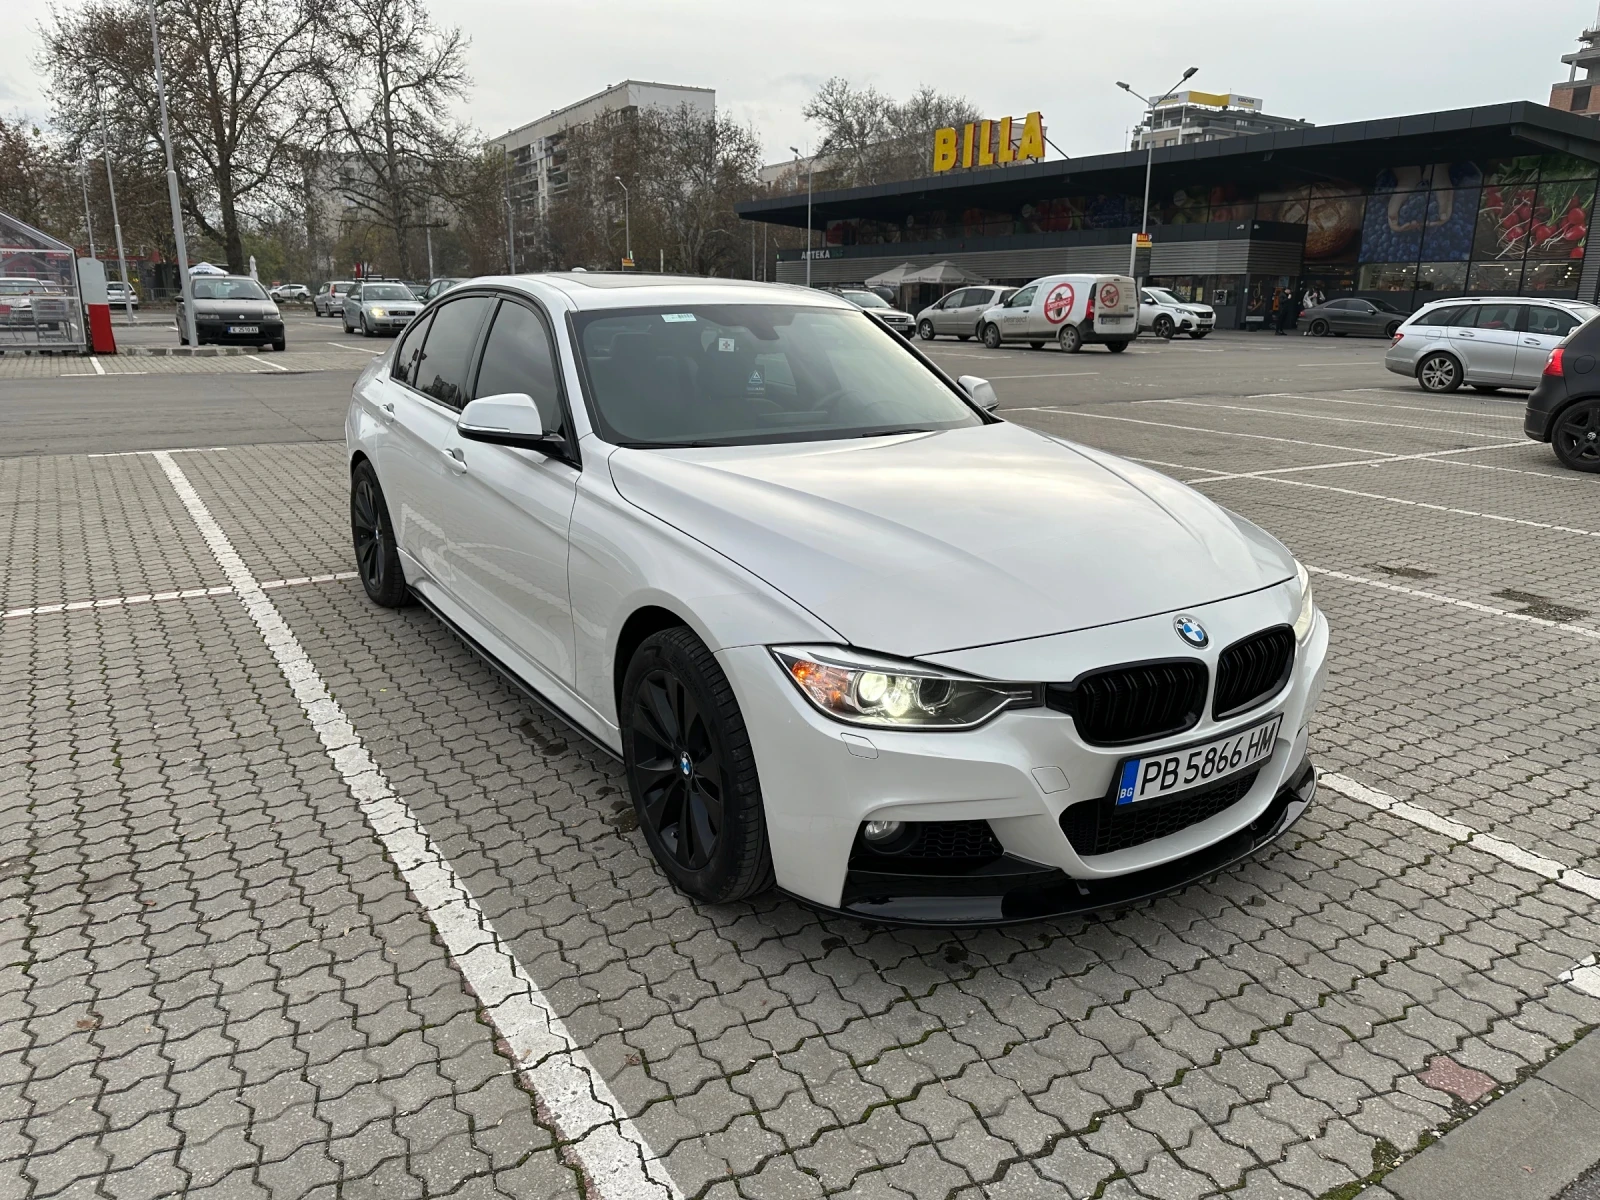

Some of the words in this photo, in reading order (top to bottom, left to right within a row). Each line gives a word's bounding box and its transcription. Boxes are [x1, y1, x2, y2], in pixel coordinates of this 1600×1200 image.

[933, 111, 1045, 172] BILLA
[1120, 787, 1133, 799] BG
[1139, 756, 1180, 796] PB
[1183, 736, 1244, 784] 5866
[1245, 722, 1276, 763] HM
